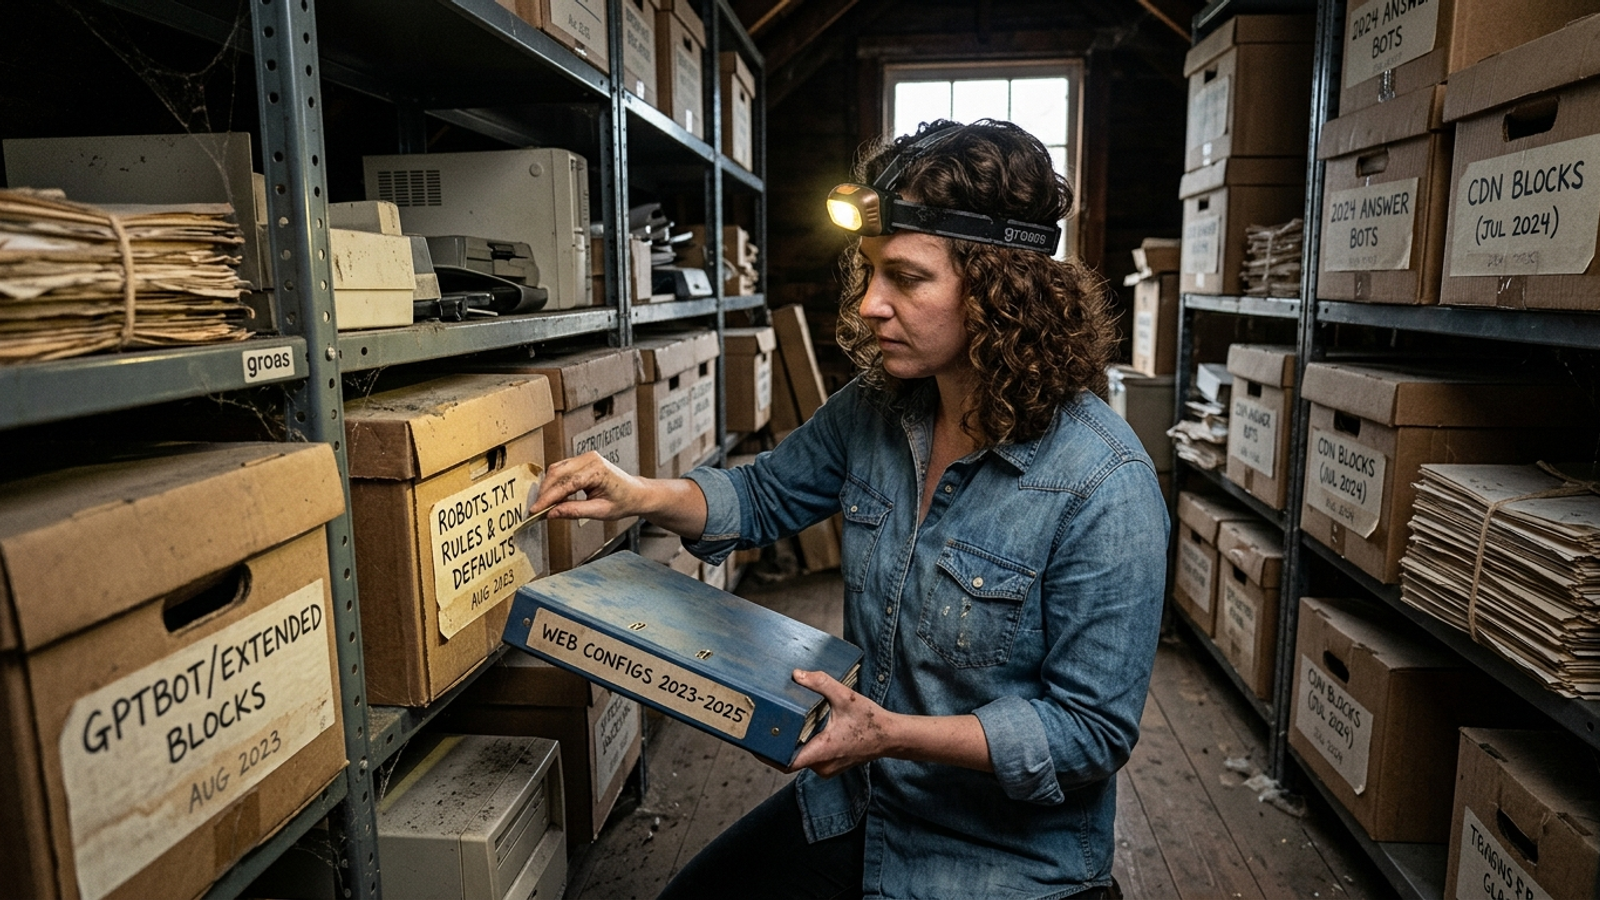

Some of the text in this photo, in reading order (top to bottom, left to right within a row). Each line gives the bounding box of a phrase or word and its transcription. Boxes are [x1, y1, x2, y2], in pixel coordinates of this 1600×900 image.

[1372, 25, 1402, 59] BOTS
[1468, 160, 1585, 206] CDN BLOCKS
[1331, 192, 1409, 223] 2024 ANSWER
[1475, 205, 1559, 246] (JUL 2024)
[1350, 227, 1378, 249] BOTS
[247, 352, 290, 378] groas
[1318, 437, 1375, 478] CDN BLOCKS
[438, 478, 516, 536] ROBOTS.TXT
[1340, 475, 1367, 505] 2024)
[441, 503, 523, 566] RULES & CDN
[452, 535, 516, 590] DEFAULTS
[471, 585, 490, 610] AUG
[82, 603, 322, 754] GPTBOT/EXTENDED
[542, 623, 578, 651] WEB
[583, 643, 653, 685] CONFIGS
[658, 675, 747, 723] 2023-2025
[166, 681, 266, 764] BLOCKS
[188, 730, 281, 814] AUG 2023
